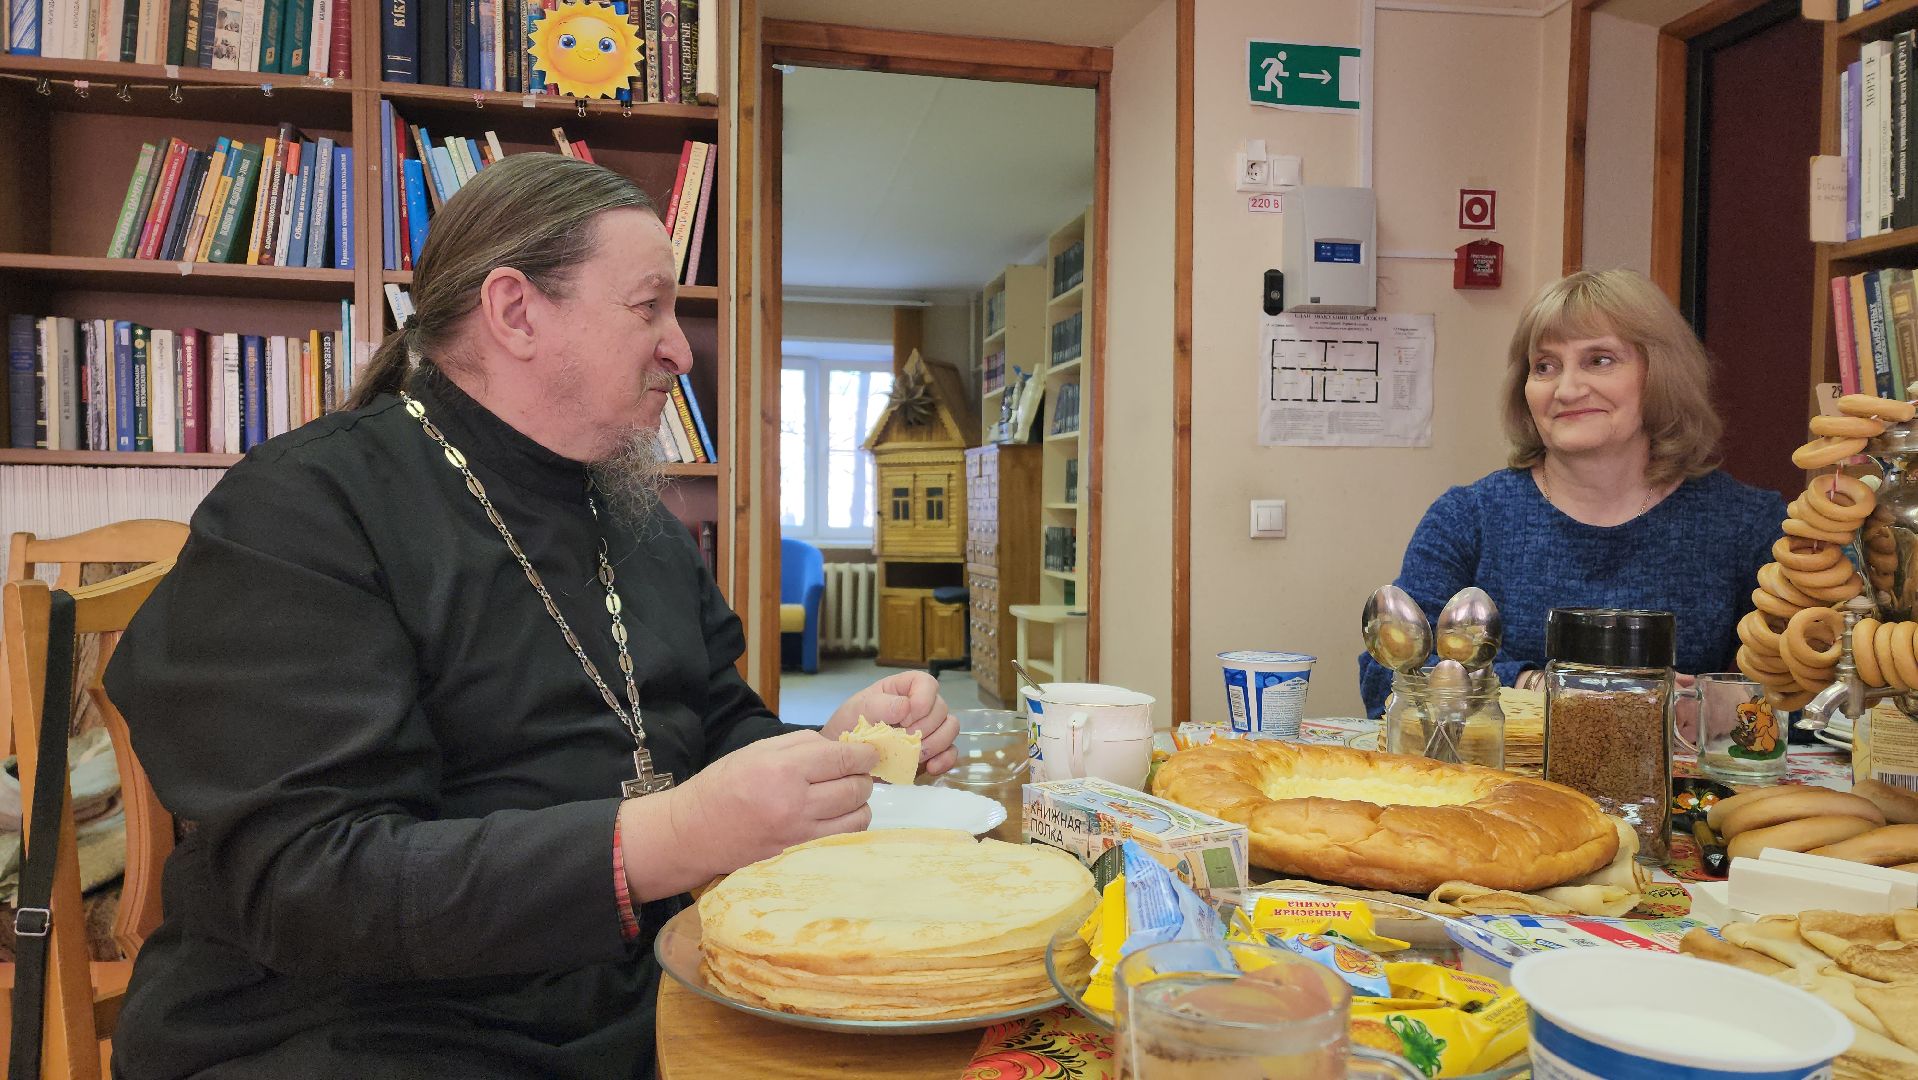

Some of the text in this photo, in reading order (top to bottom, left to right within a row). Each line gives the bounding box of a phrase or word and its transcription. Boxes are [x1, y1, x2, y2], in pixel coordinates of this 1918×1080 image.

[186, 19, 197, 50] ИЛЬЯ
[679, 22, 693, 80] НЕСВЯТЫЕ
[127, 174, 145, 210] ПАМЯТЬ
[1250, 197, 1271, 209] 220
[322, 336, 331, 369] СЕНЕКА
[1874, 352, 1884, 374] МИР
[1030, 803, 1083, 836] КНИЖНАЯ
[1030, 817, 1065, 847] ПОЛКА
[1273, 907, 1354, 922] Ананасная
